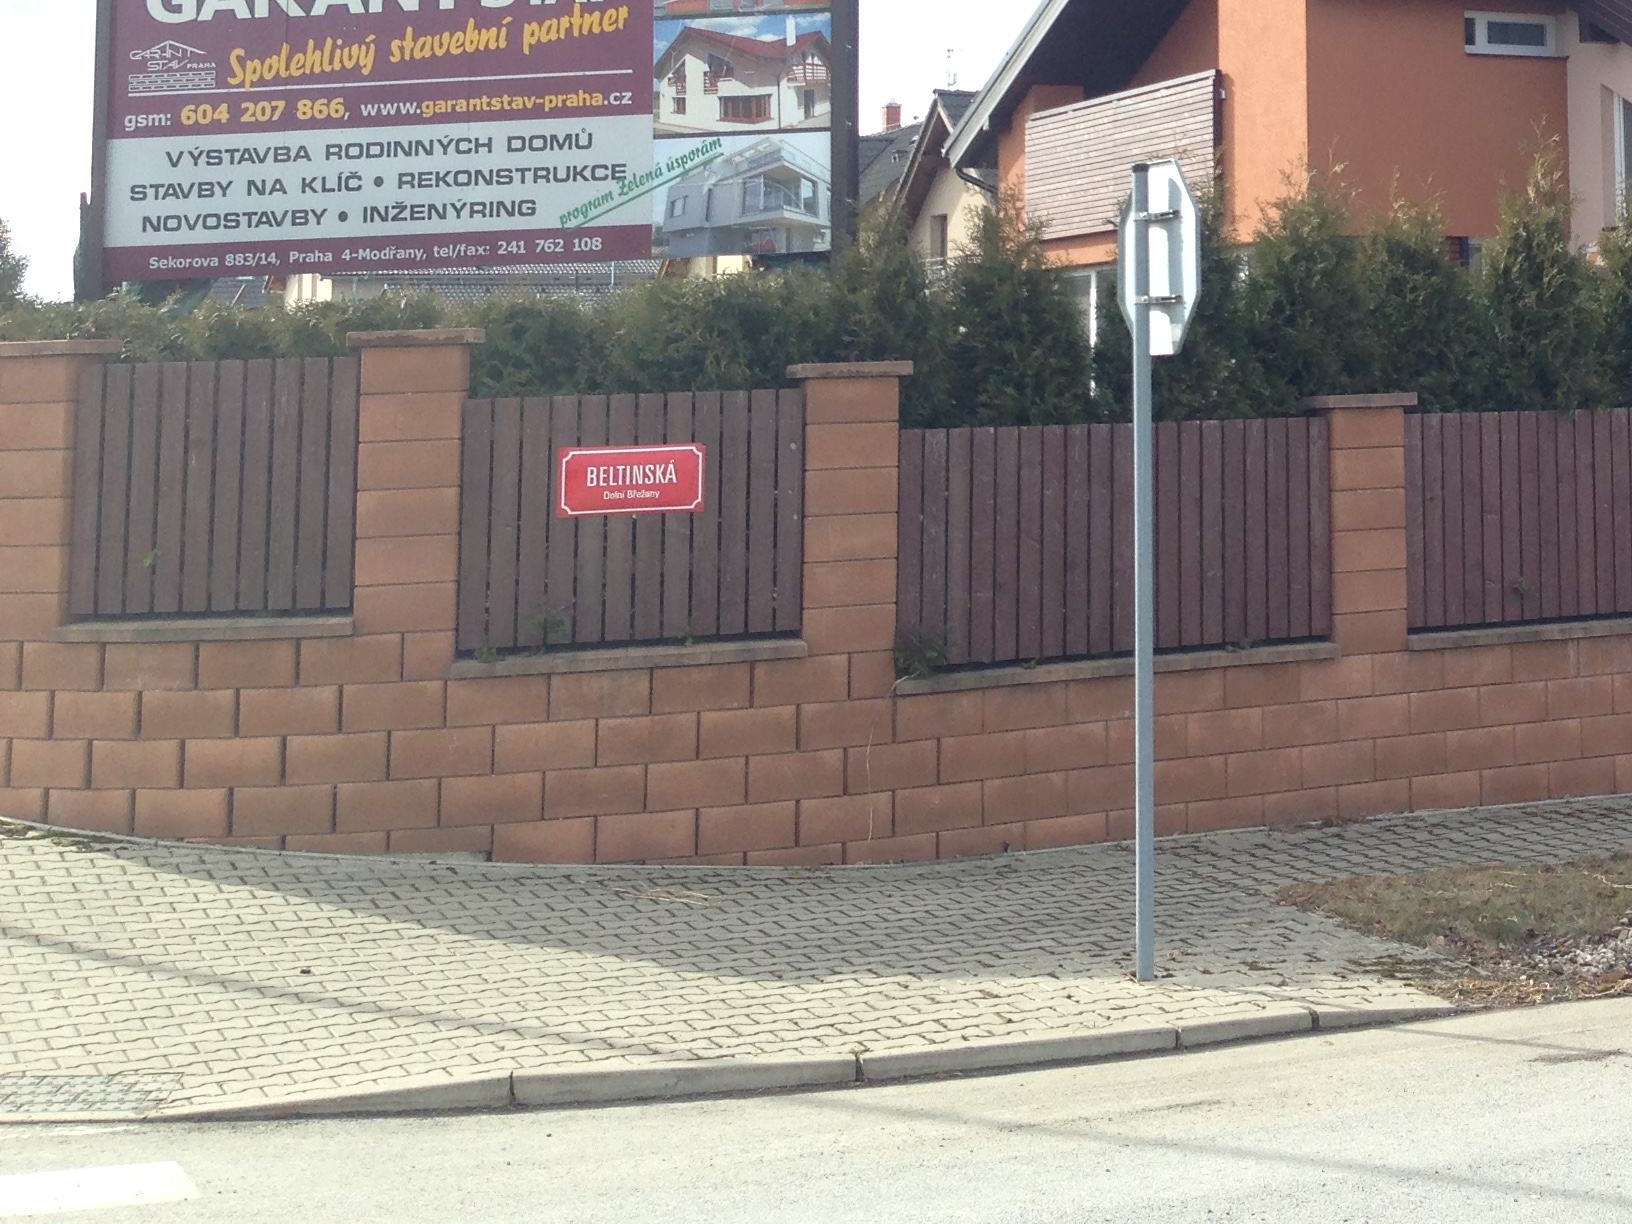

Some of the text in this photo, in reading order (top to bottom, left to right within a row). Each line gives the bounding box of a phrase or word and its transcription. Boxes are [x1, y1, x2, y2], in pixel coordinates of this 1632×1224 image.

[227, 3, 628, 91] Spolehlivý stavební partner
[124, 89, 632, 131] gsm: 604 207 866, www.garantstav-praha.cz
[165, 127, 593, 168] VÝSTAVBA RODINNÝCH DOMŮ
[130, 162, 627, 202] STAVBY NA KLÍČ REKONSTRUKCE
[558, 190, 614, 228] program
[666, 137, 723, 172] úsporám
[141, 198, 537, 233] NOVOSTAVBY INŽENÝRING
[149, 236, 603, 269] Sekorova 883/14, Praha 4-Modřany, tel/fax: 241 762 108
[587, 459, 677, 487] BELTINSKÁ
[603, 489, 625, 500] Dolní
